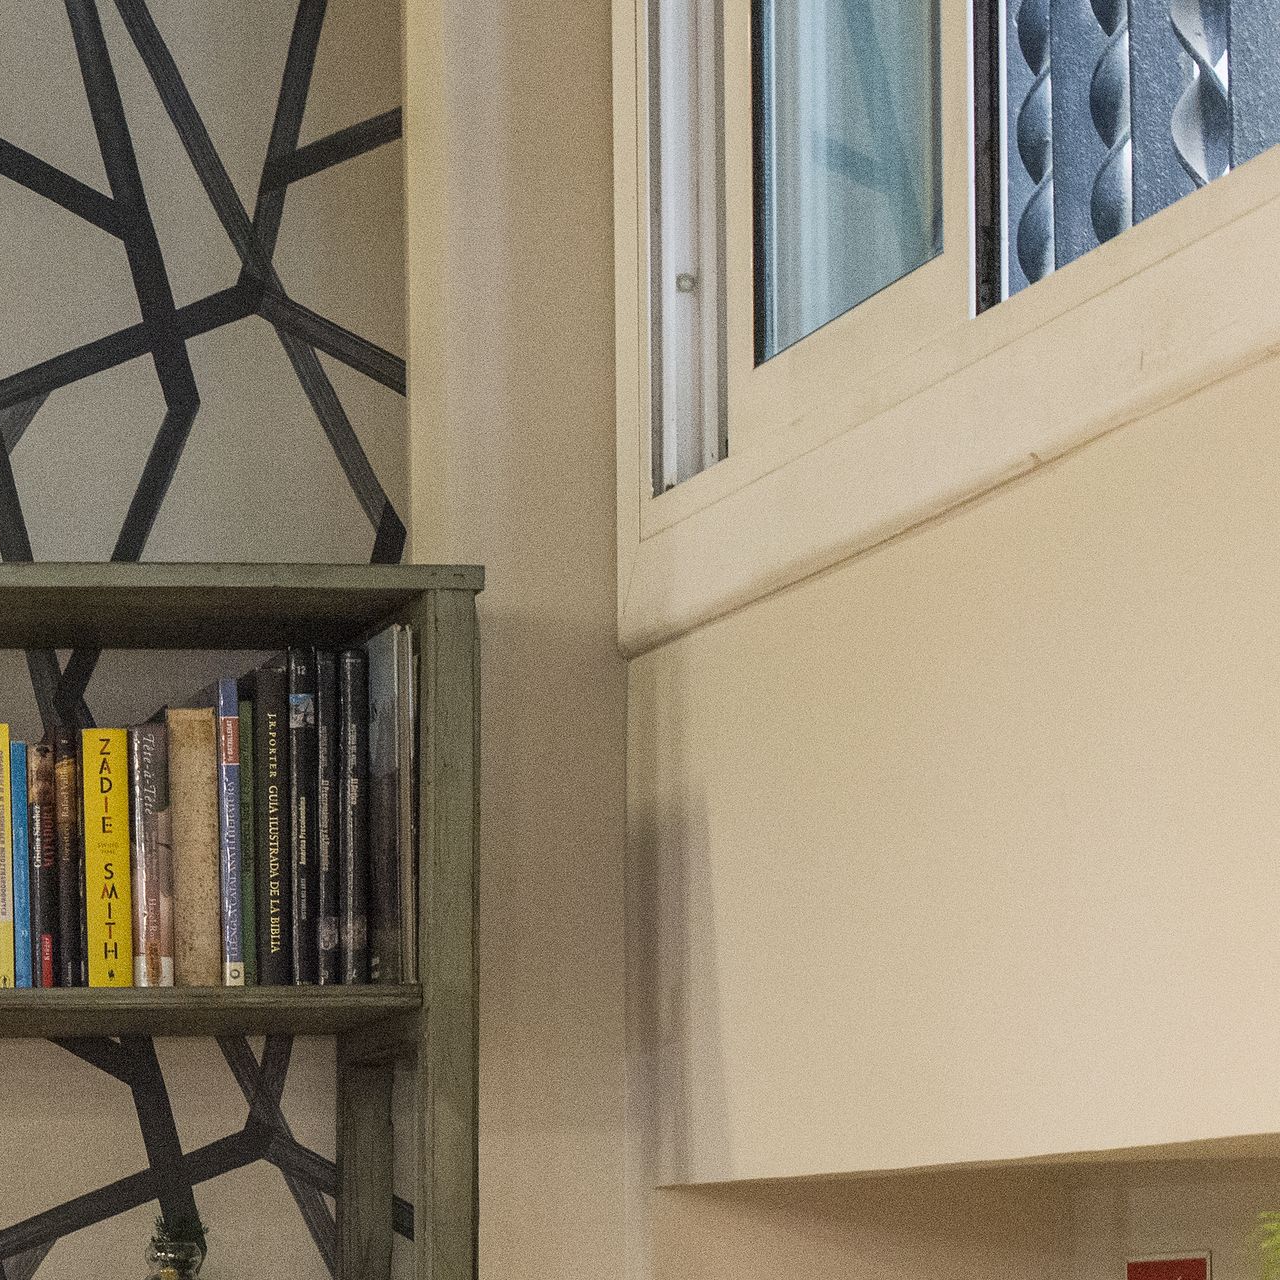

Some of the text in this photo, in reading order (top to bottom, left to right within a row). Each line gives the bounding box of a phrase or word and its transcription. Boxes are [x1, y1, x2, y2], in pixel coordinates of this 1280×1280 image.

[98, 738, 114, 834] ZADIE
[267, 784, 278, 813] GUIA
[268, 816, 279, 877] ILUSTRADA
[228, 851, 237, 906] CATALANA
[269, 880, 279, 895] DE
[100, 862, 120, 960] SMITH
[269, 899, 280, 913] LA
[270, 916, 280, 952] BIBLIA
